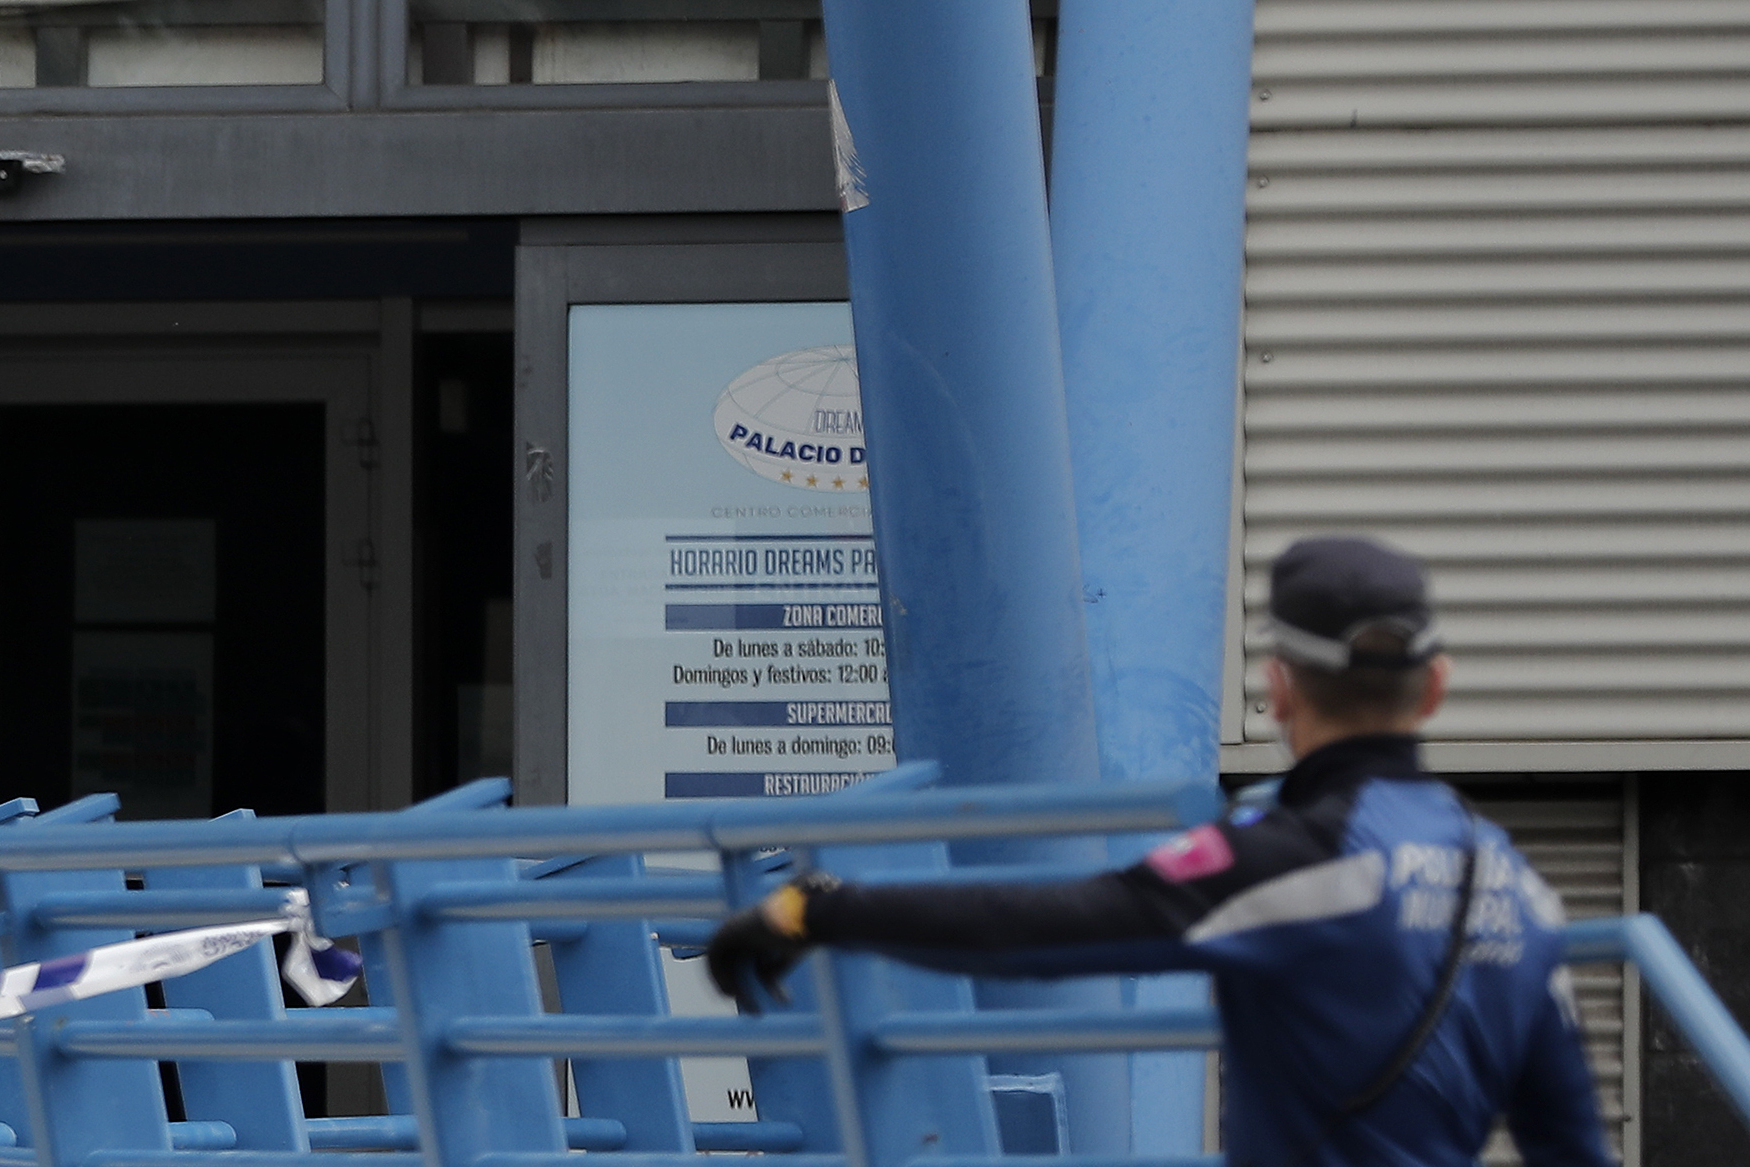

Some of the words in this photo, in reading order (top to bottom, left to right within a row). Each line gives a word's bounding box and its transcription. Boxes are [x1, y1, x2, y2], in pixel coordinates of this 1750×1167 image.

[729, 423, 842, 464] PALACIO
[711, 506, 781, 518] CENTRO
[671, 550, 757, 575] HORARIO
[766, 549, 844, 575] DREAMS
[852, 549, 876, 574] PA
[783, 605, 823, 627] ZONA
[714, 639, 733, 657] De
[738, 638, 778, 657] lunes
[784, 643, 792, 657] a
[798, 638, 857, 657] sábado:
[673, 664, 748, 688] Domingos
[752, 668, 762, 687] y
[768, 664, 831, 684] festivos:
[838, 664, 877, 683] 12:00
[708, 736, 726, 755] De
[732, 735, 772, 755] lunes
[778, 740, 786, 755] a
[792, 735, 861, 759] domingo:
[868, 735, 894, 755] 09:
[764, 771, 874, 796] RESTAURACI
